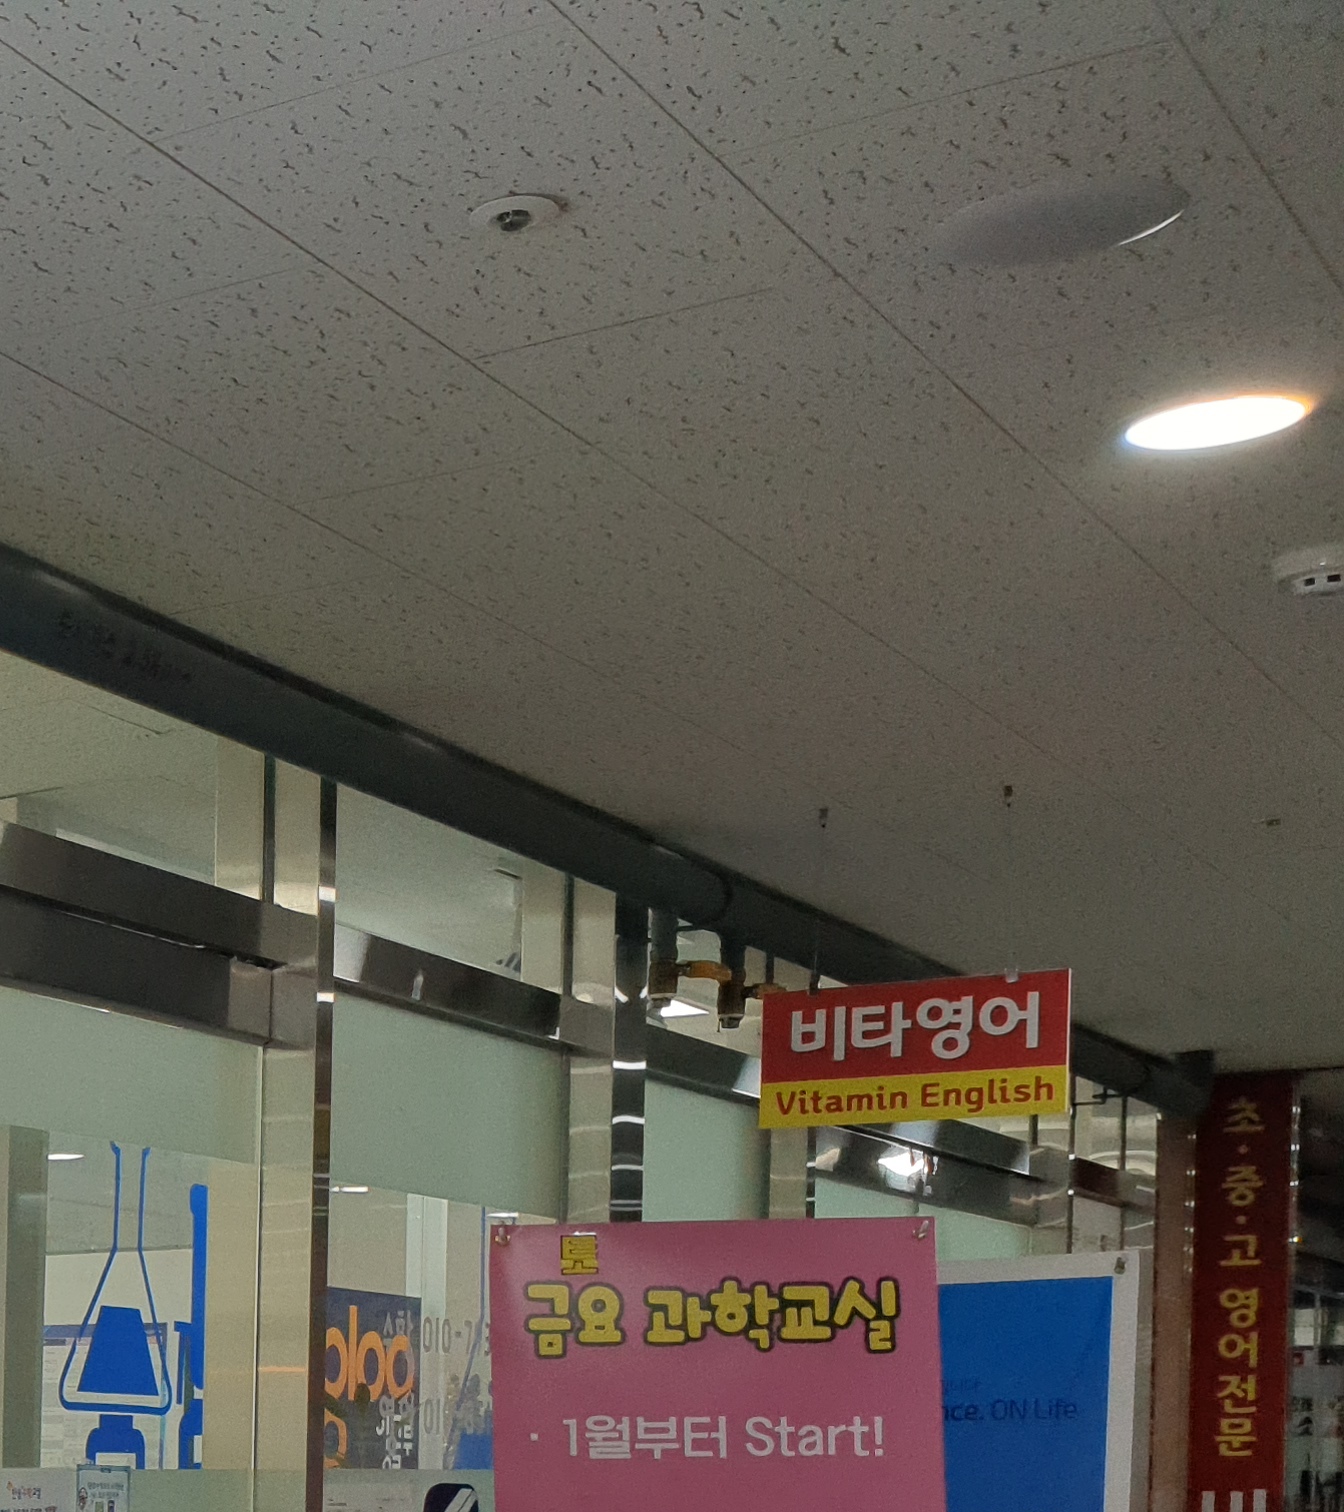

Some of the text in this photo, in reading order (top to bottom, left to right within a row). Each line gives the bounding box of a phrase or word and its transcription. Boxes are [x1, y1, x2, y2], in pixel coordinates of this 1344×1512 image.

[790, 991, 1039, 1061] 비타영어
[775, 1075, 1055, 1116] Vitamin English
[522, 1276, 901, 1358] 금요 과학교실
[562, 1415, 885, 1460] 1월부터 Start!
